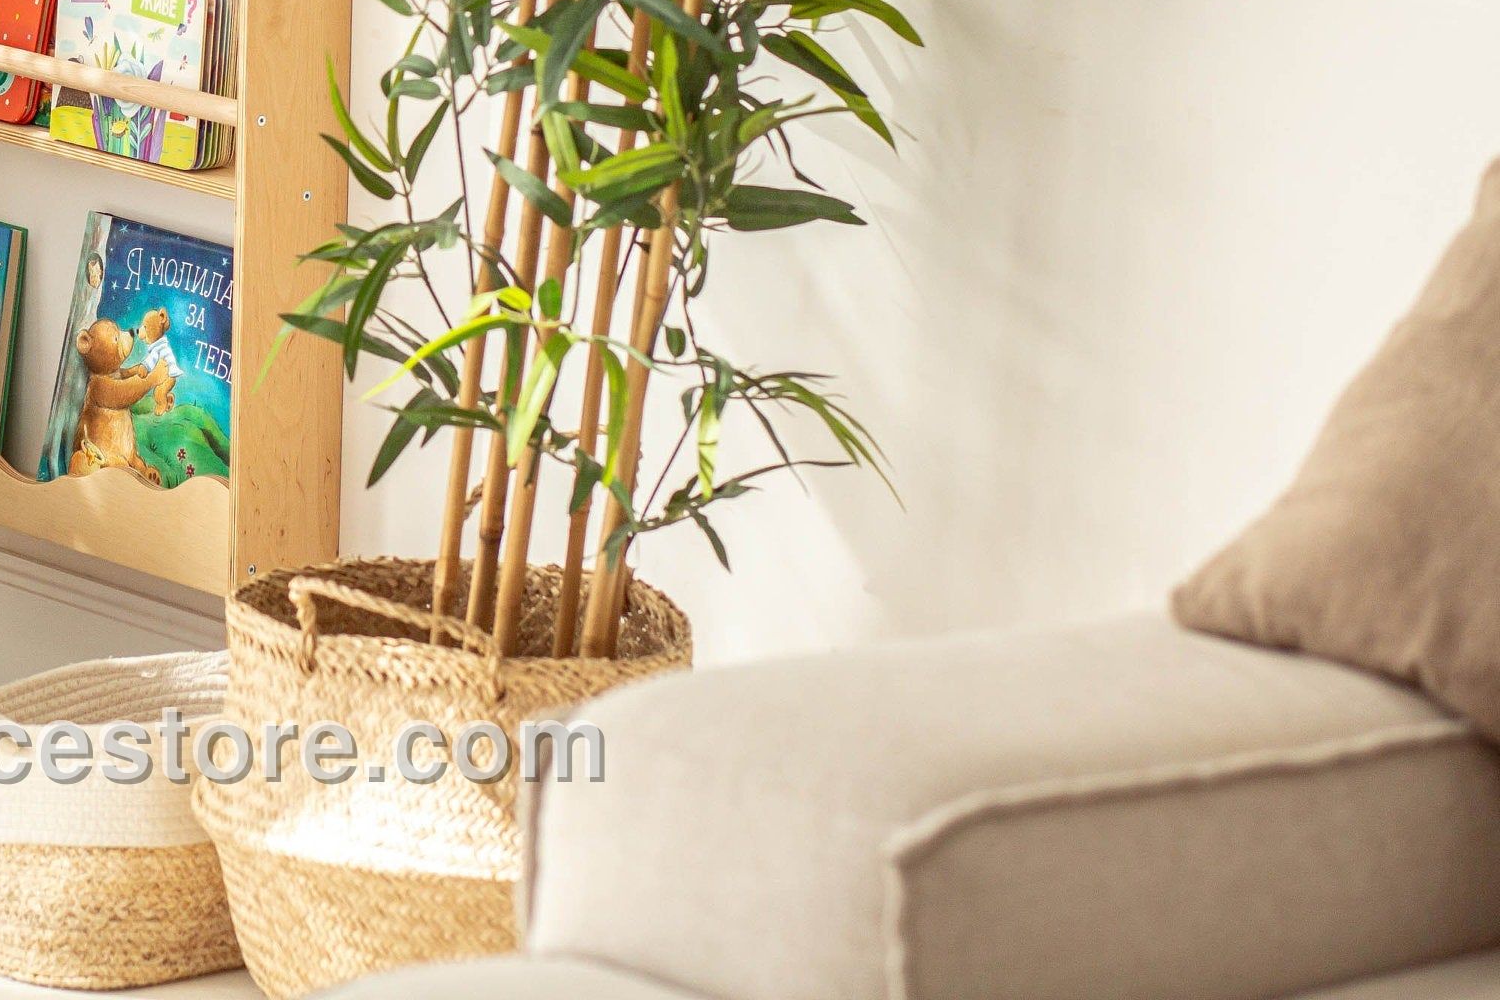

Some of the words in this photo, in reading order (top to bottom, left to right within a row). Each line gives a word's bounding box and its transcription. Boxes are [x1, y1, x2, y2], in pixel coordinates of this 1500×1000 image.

[124, 247, 144, 291] Я
[185, 303, 206, 331] ЗА
[194, 340, 233, 385] ТЕБ
